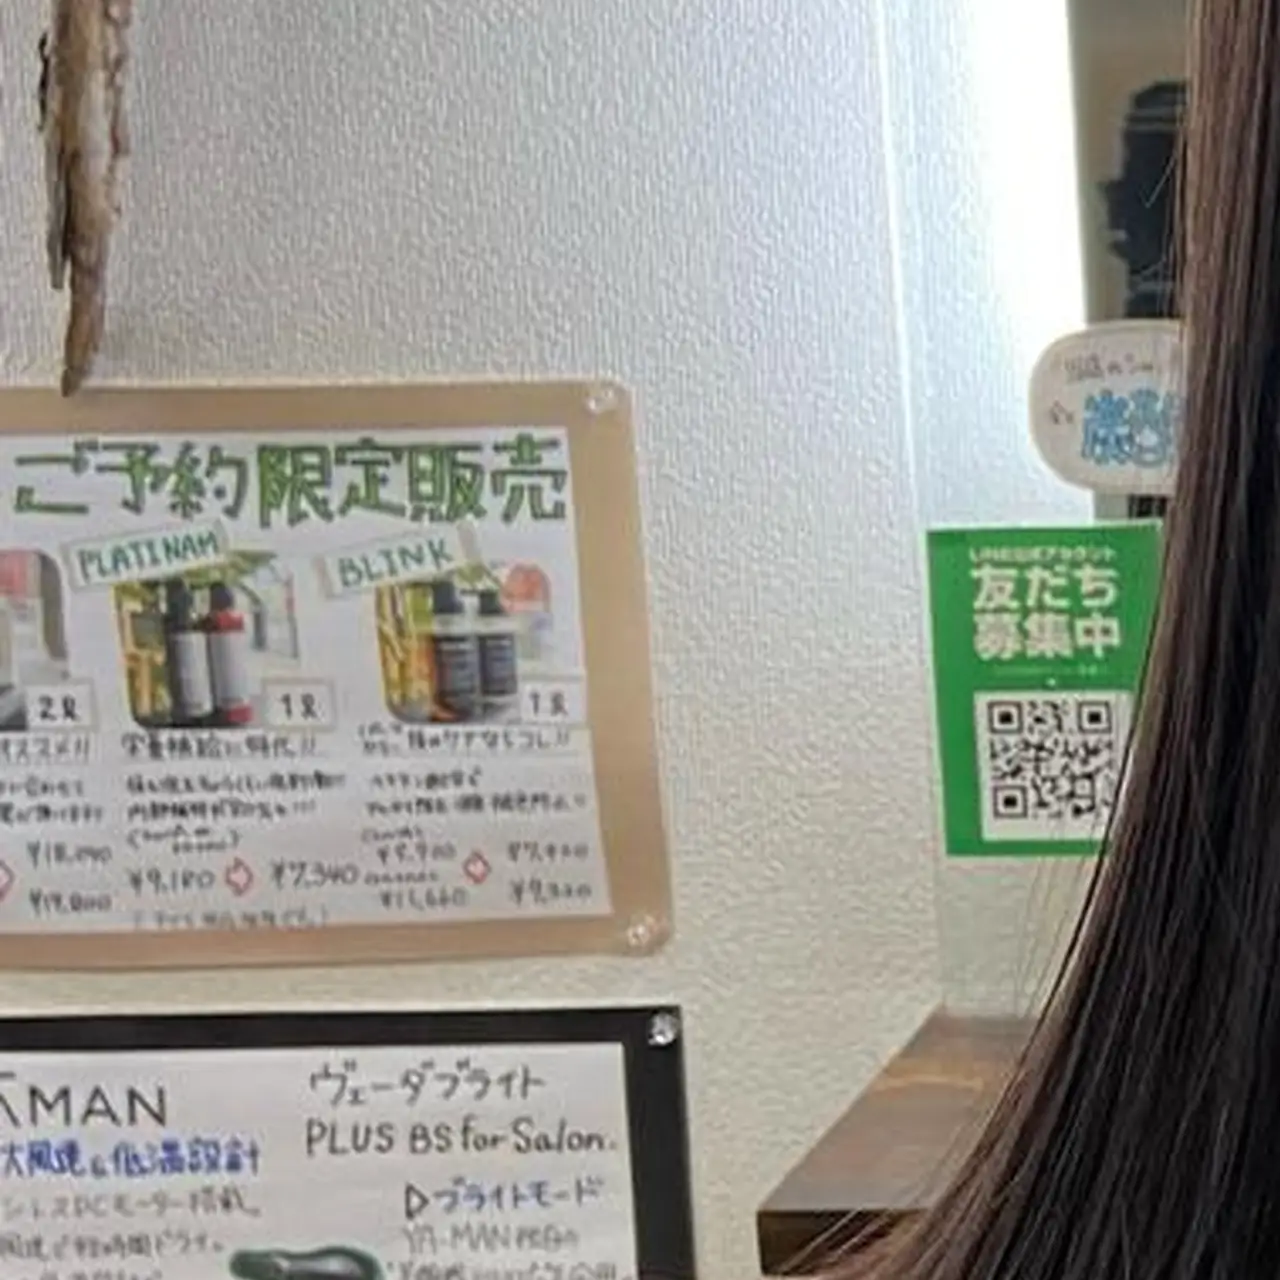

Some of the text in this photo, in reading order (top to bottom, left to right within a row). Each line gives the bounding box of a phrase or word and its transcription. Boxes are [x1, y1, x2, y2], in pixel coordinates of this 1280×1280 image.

[14, 433, 568, 527] ご予約限定販売
[337, 537, 455, 589] BLINK
[970, 563, 1118, 610] 友だち
[972, 611, 1121, 661] 募集中
[306, 1118, 397, 1158] PLUS
[409, 1122, 453, 1154] BS
[460, 1113, 507, 1154] for
